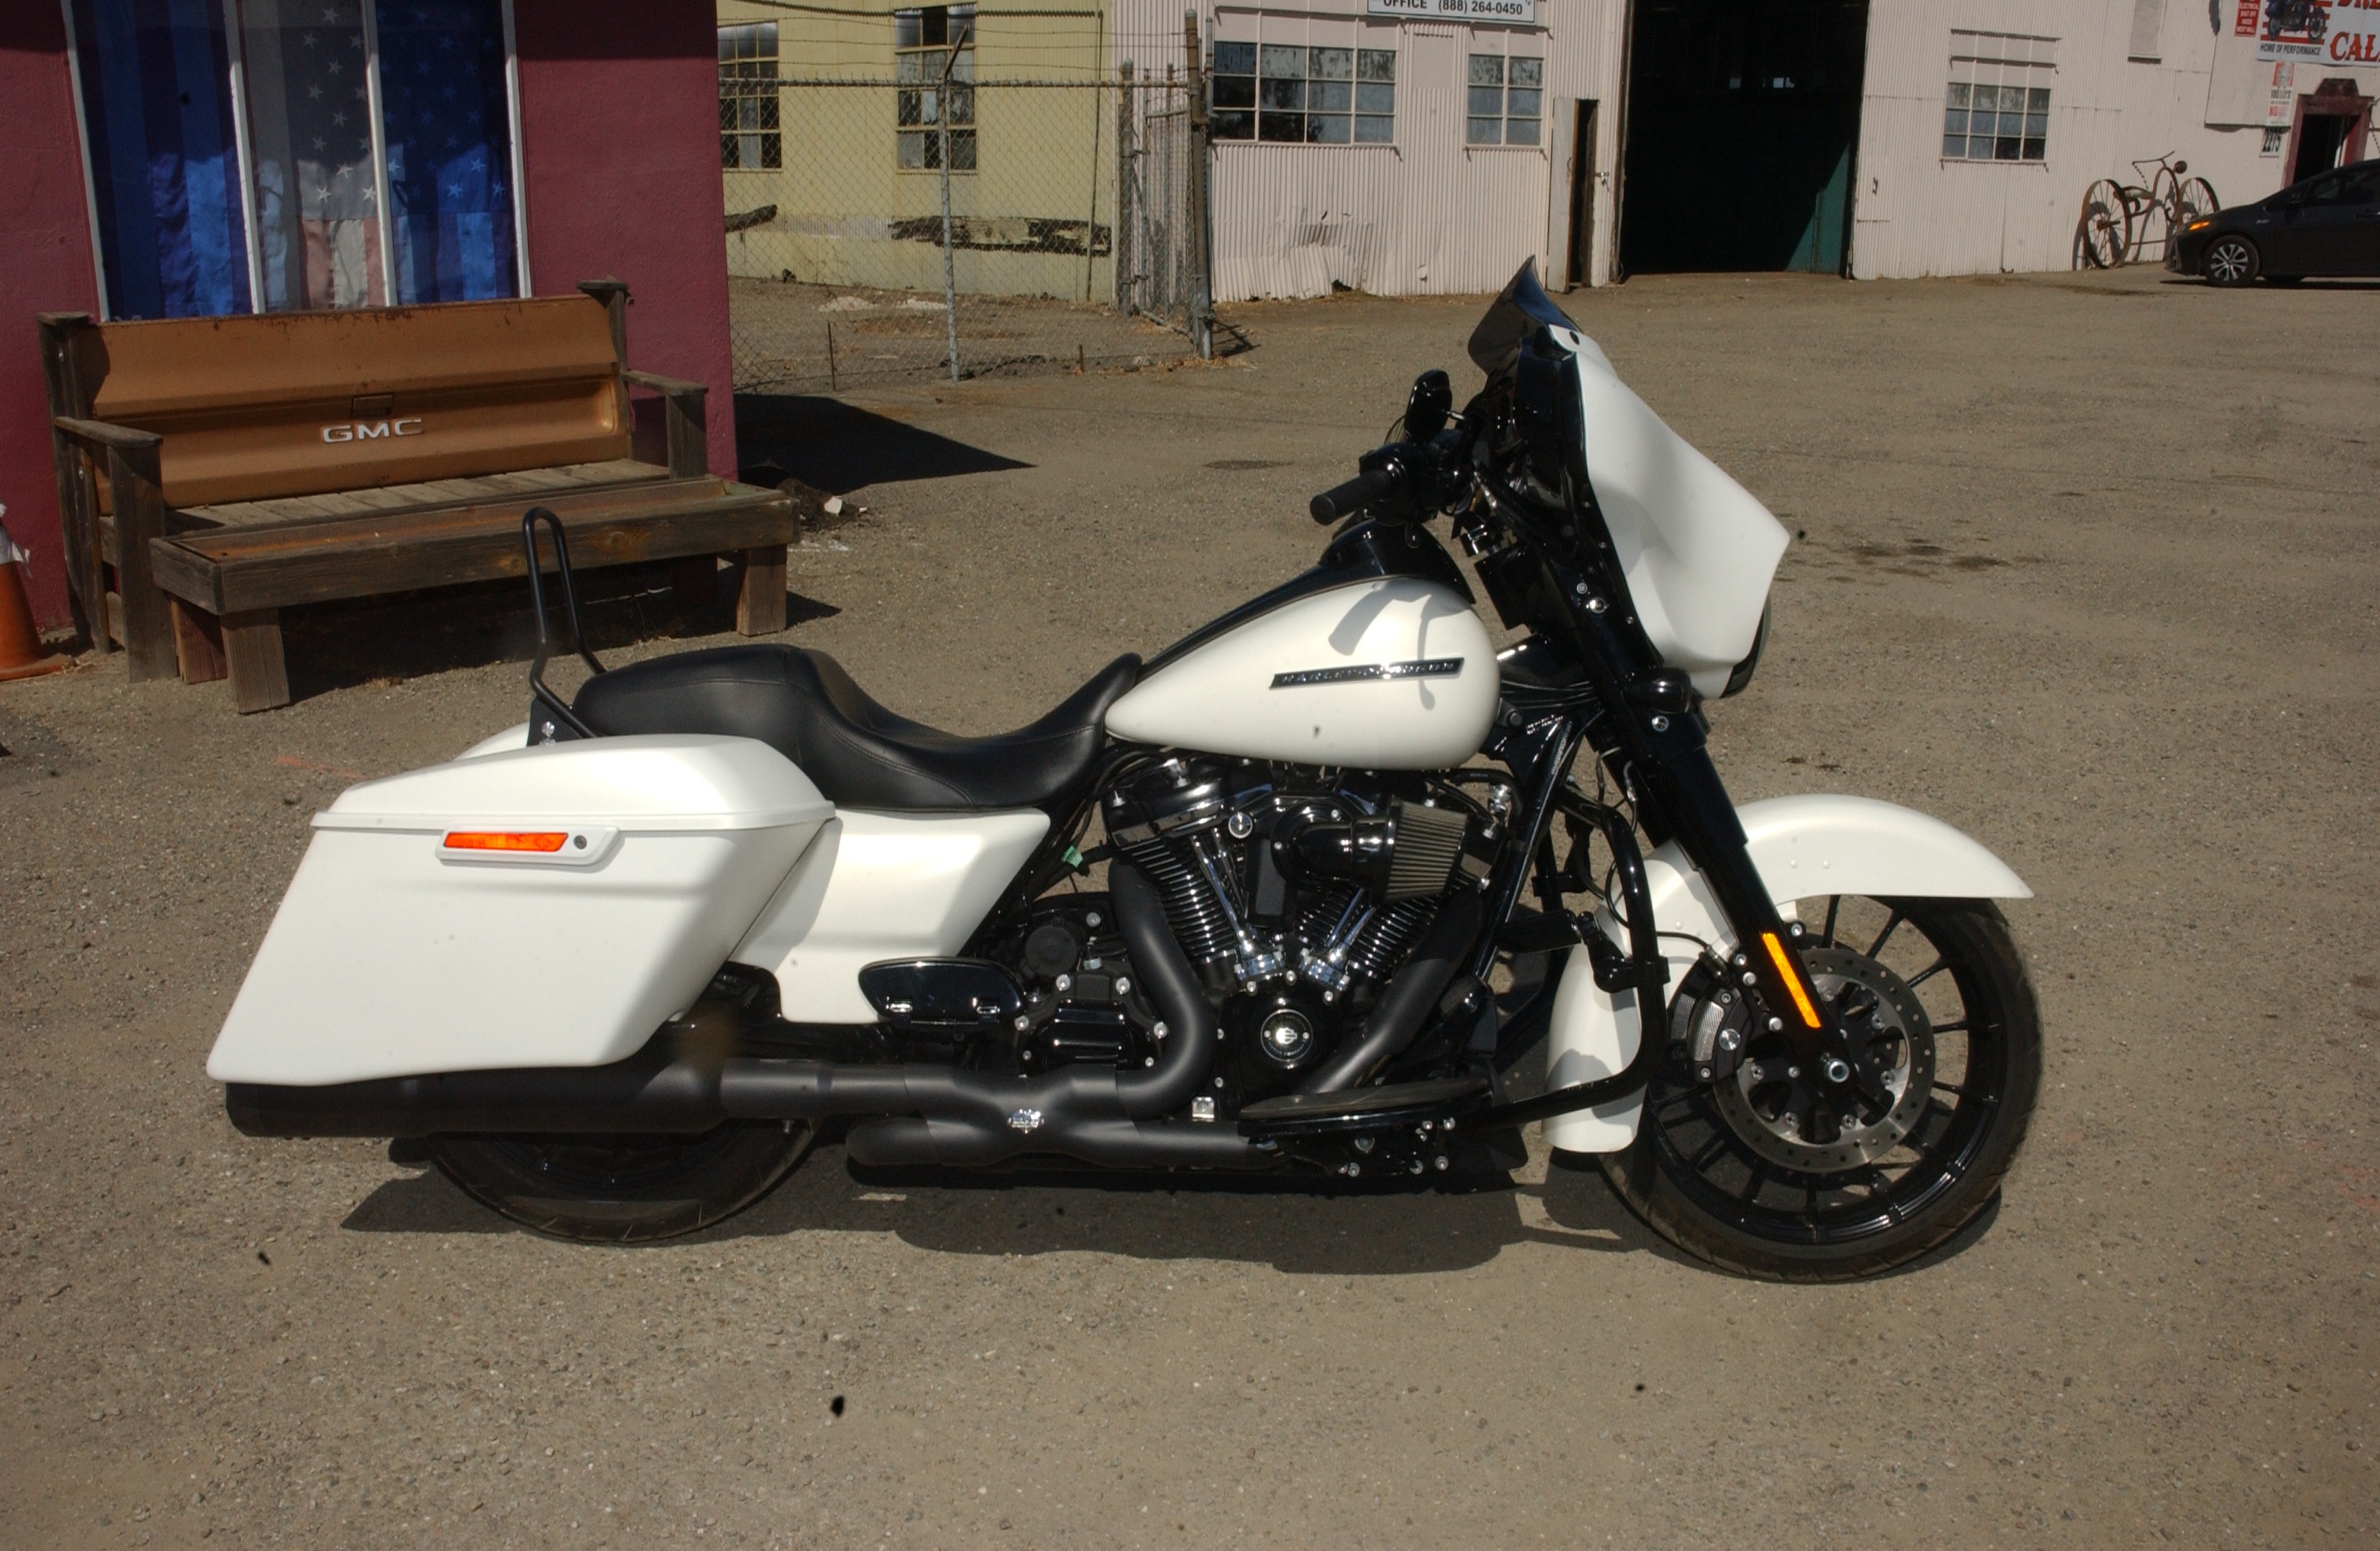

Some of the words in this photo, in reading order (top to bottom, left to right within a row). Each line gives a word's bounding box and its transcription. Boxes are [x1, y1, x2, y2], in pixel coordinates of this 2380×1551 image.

[1384, 0, 1427, 9] OFFICE
[1438, 0, 1467, 13] (888)
[1472, 1, 1522, 15] 264-0450
[2260, 43, 2275, 53] HOME
[2276, 44, 2283, 53] OF
[2283, 45, 2321, 56] PERFORMANCE
[2329, 32, 2380, 62] CAL
[322, 418, 423, 443] GMC
[1282, 662, 1455, 683] HARLEY-DIDSON
